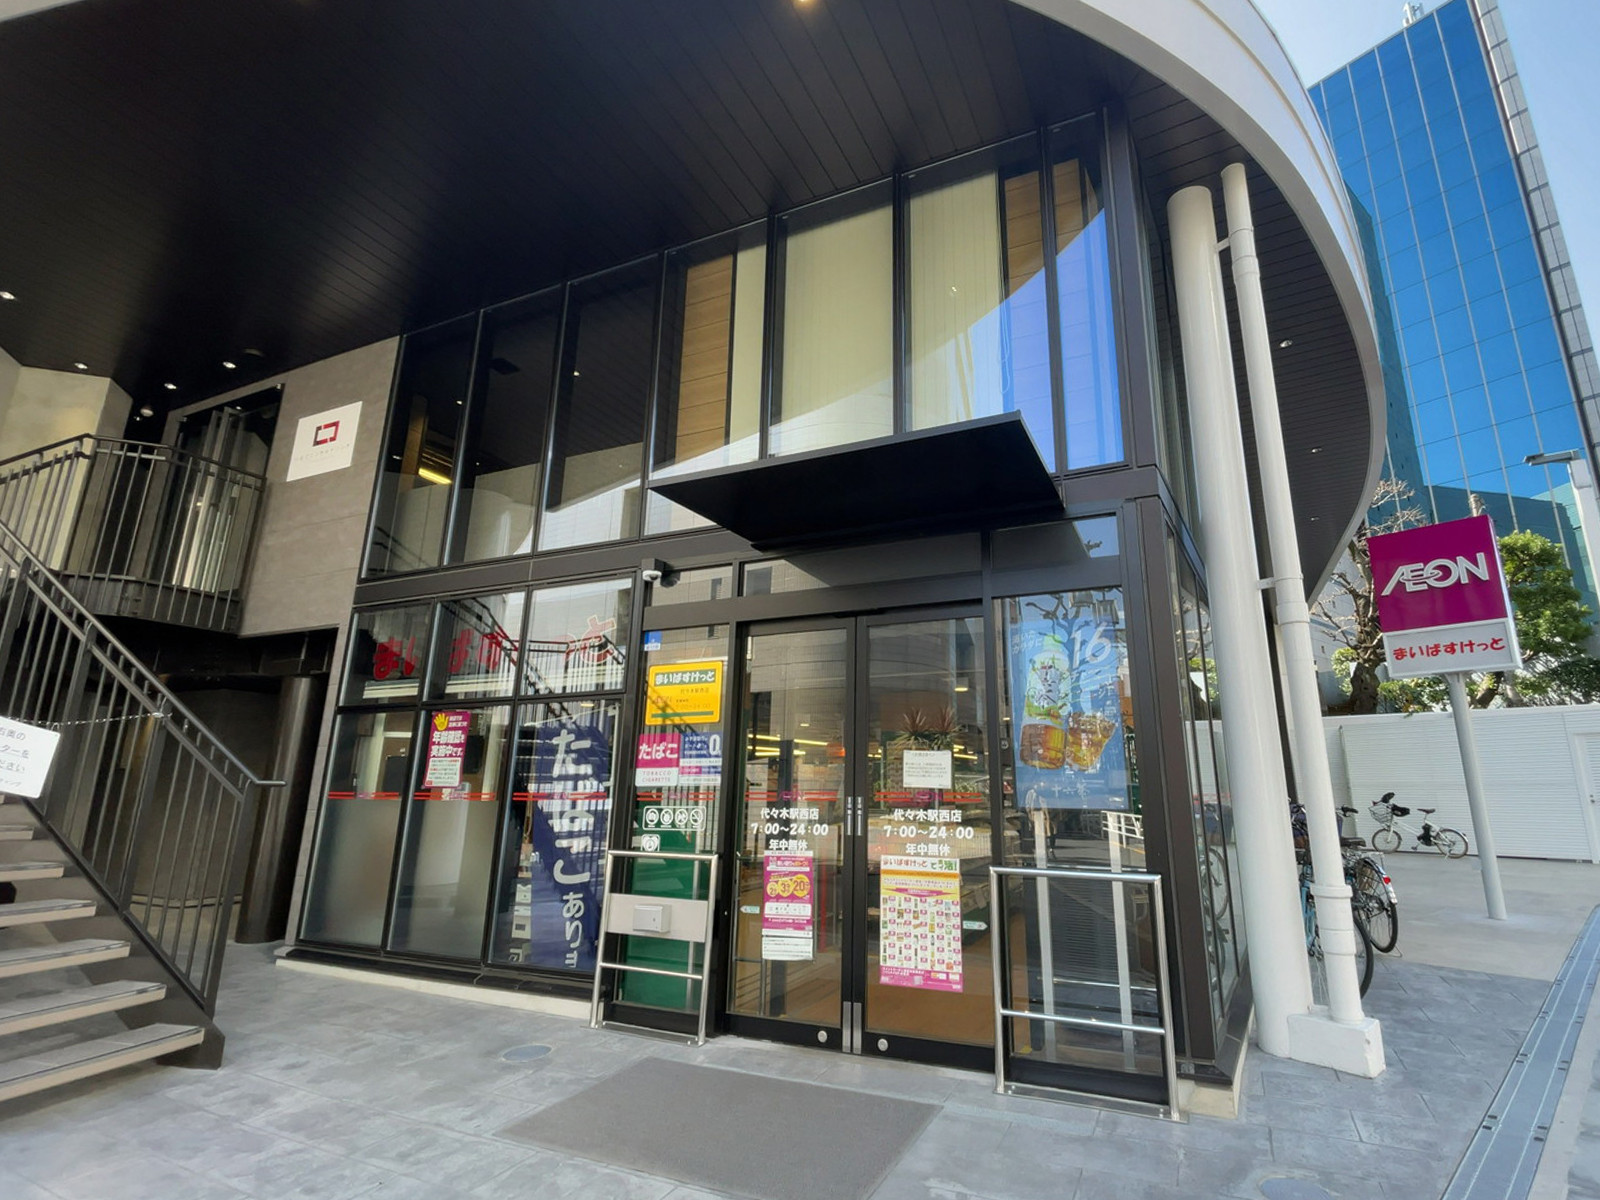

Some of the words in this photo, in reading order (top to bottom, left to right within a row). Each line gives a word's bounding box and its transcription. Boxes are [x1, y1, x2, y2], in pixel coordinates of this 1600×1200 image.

[1393, 637, 1506, 661] まいばすけっと
[656, 671, 715, 685] まいばすけっと
[638, 742, 678, 760] たばこ
[760, 807, 820, 821] 代々木駅西店
[893, 808, 962, 823] 代々木駅西店
[768, 839, 808, 851] 年中無休
[905, 843, 951, 856] 年中無休
